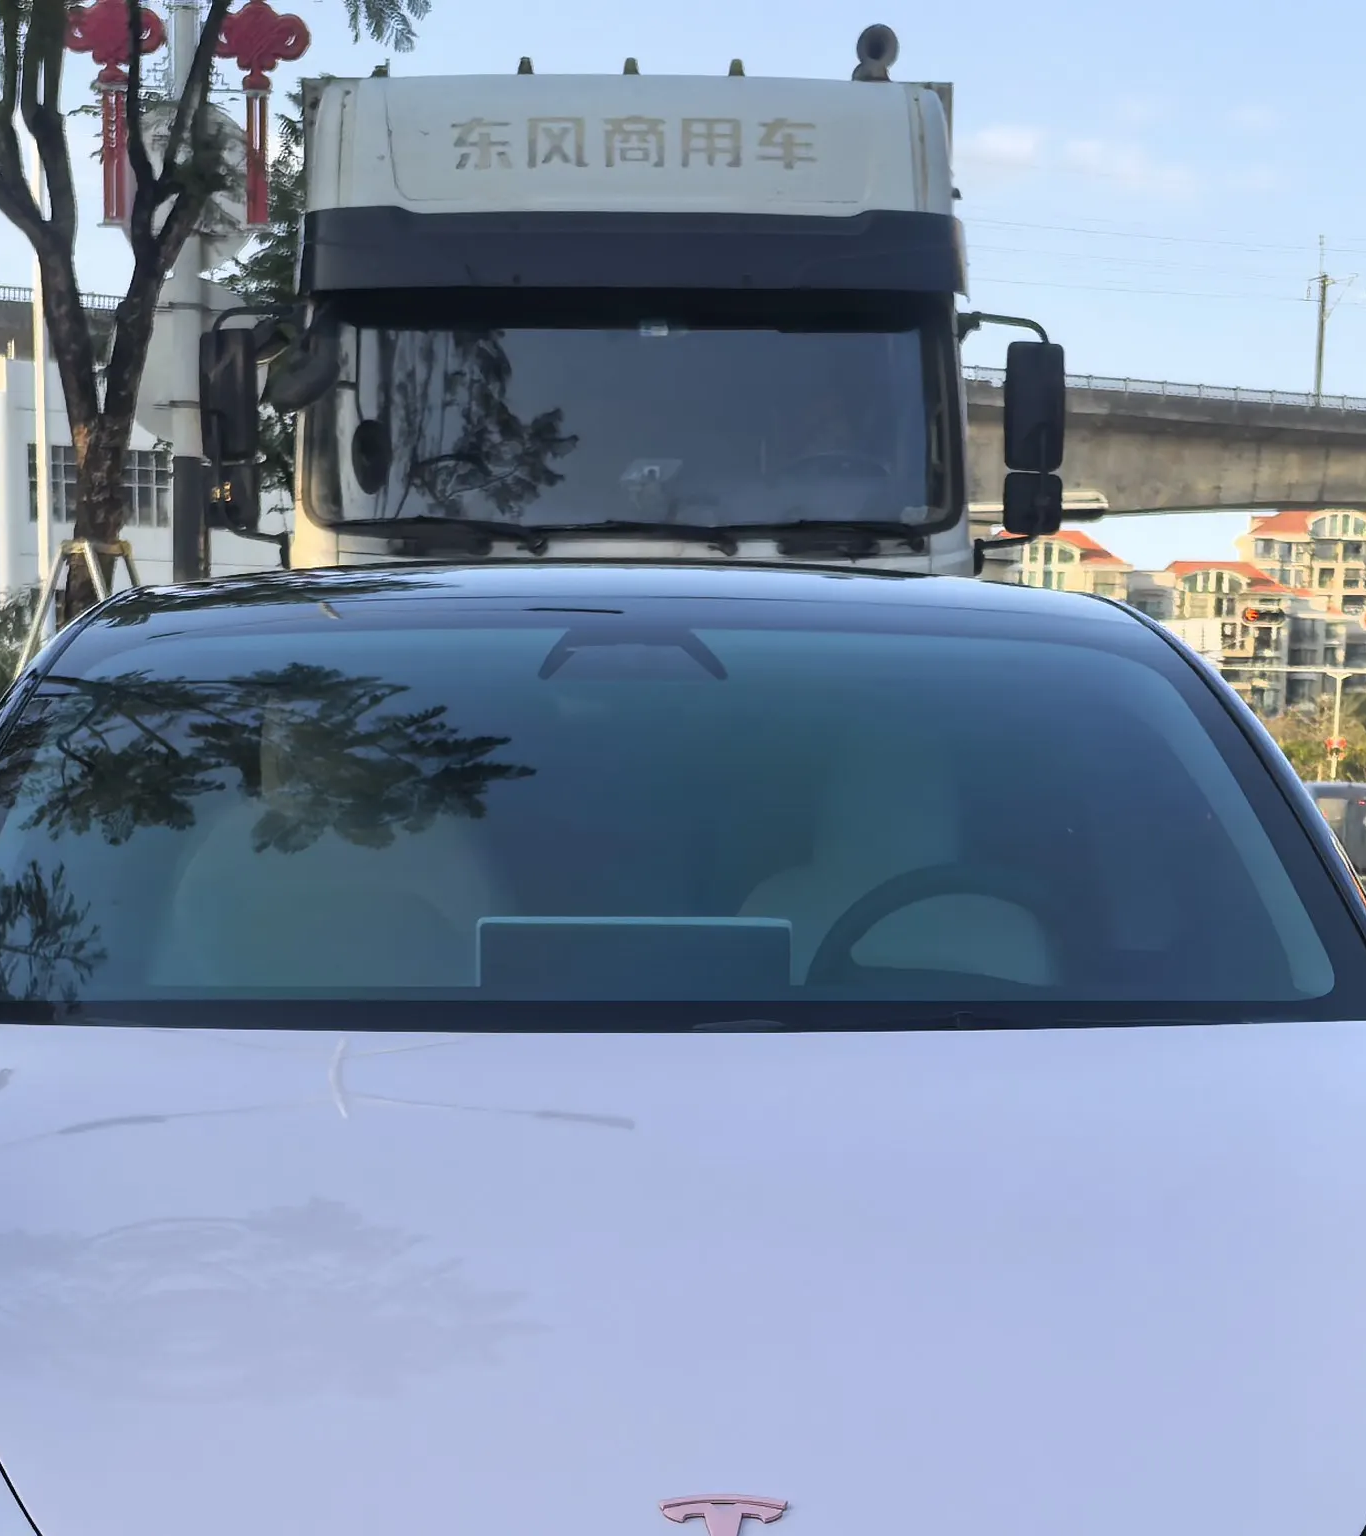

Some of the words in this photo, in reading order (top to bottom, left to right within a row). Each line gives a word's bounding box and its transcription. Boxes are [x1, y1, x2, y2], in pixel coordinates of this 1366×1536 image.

[450, 114, 818, 170] 东风商用车
